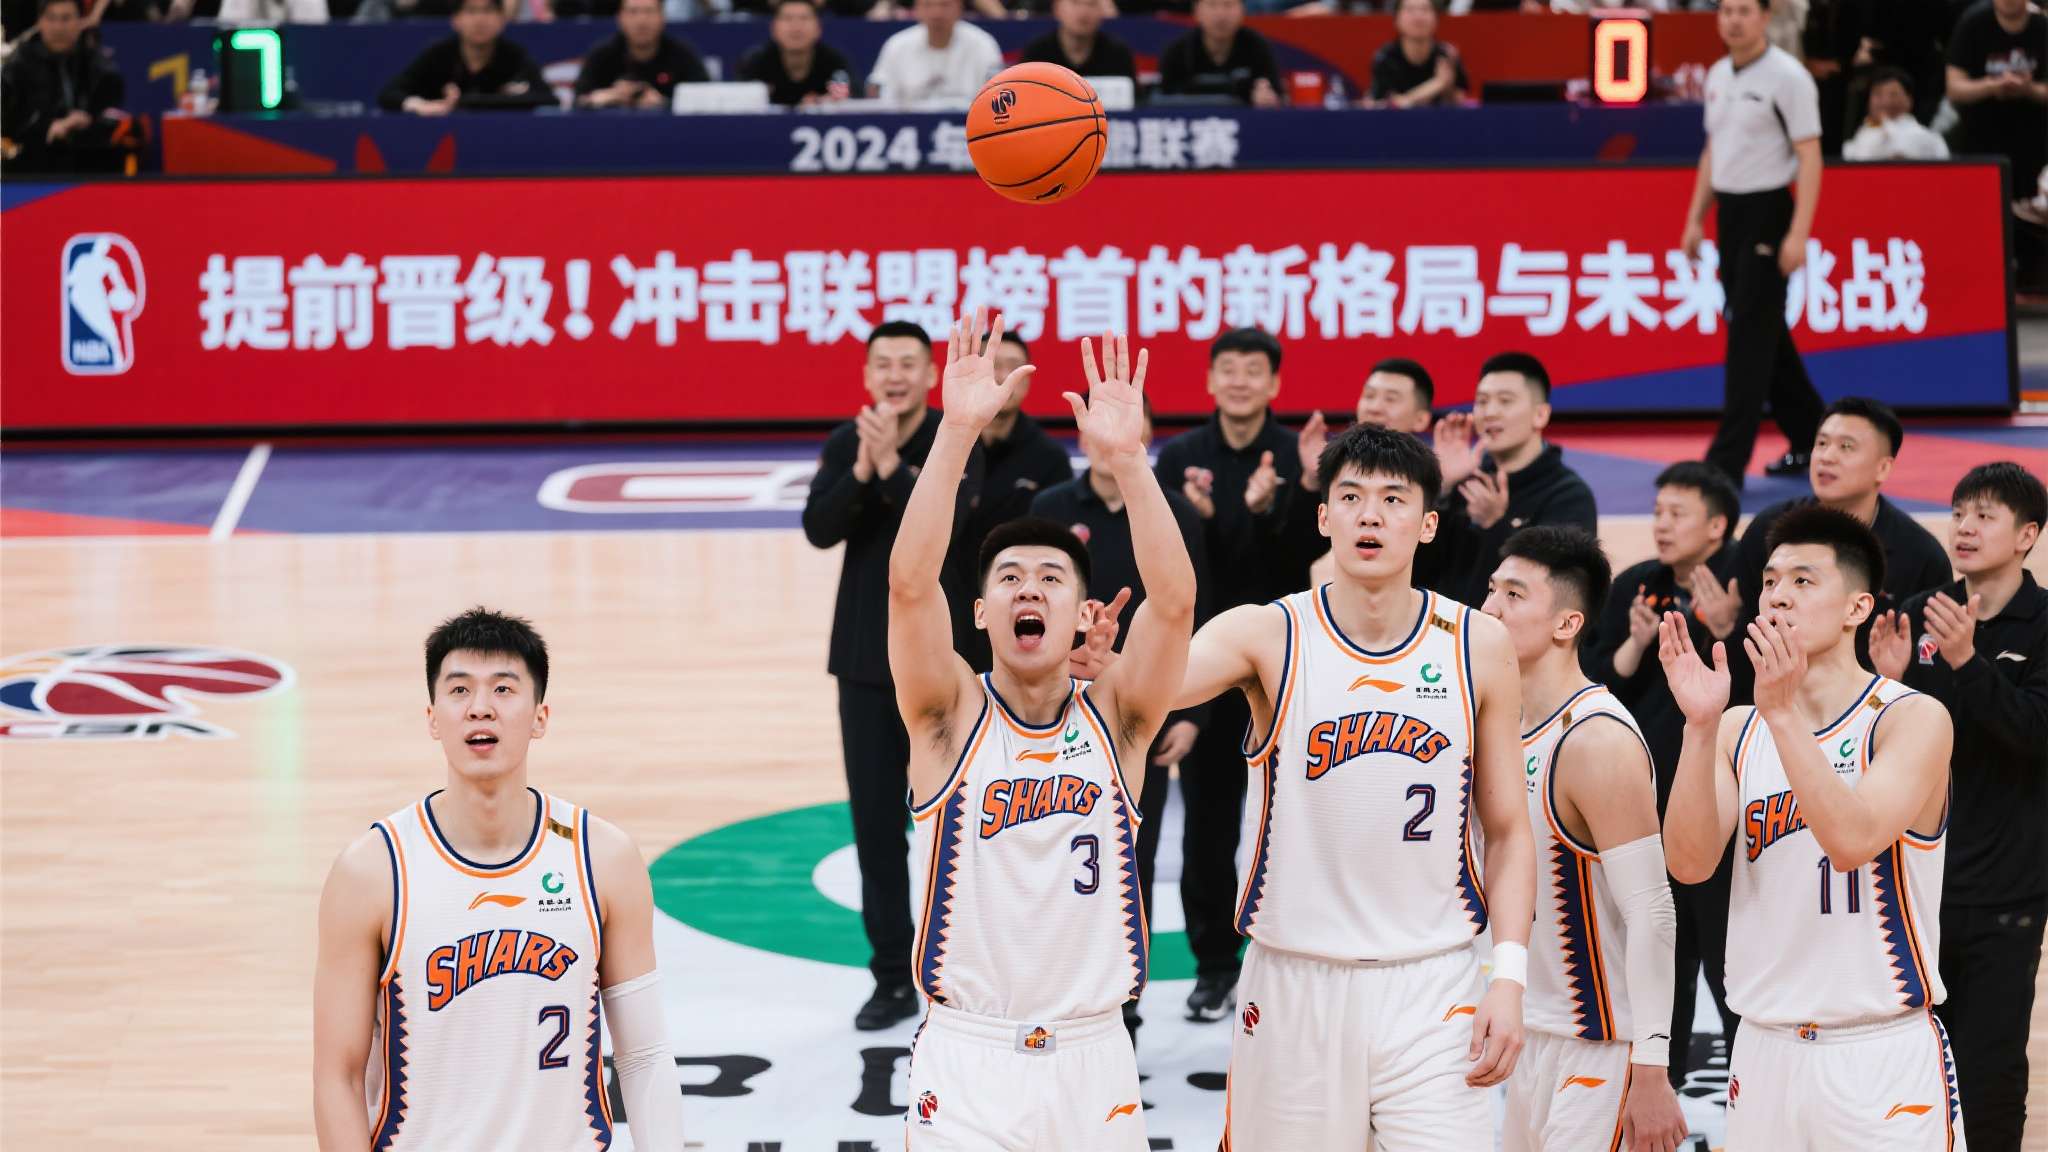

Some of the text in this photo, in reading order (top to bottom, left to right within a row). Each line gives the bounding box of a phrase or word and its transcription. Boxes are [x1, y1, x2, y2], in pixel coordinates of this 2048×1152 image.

[230, 28, 282, 109] 7
[1594, 19, 1648, 103] 0
[789, 125, 922, 172] 2024
[1305, 710, 1453, 781] SHARS
[979, 774, 1103, 840] SHARS
[1402, 783, 1437, 842] 2
[1070, 833, 1100, 895] 3
[1817, 855, 1860, 915] 11
[425, 928, 580, 1013] SHARS
[537, 1004, 571, 1071] 2
